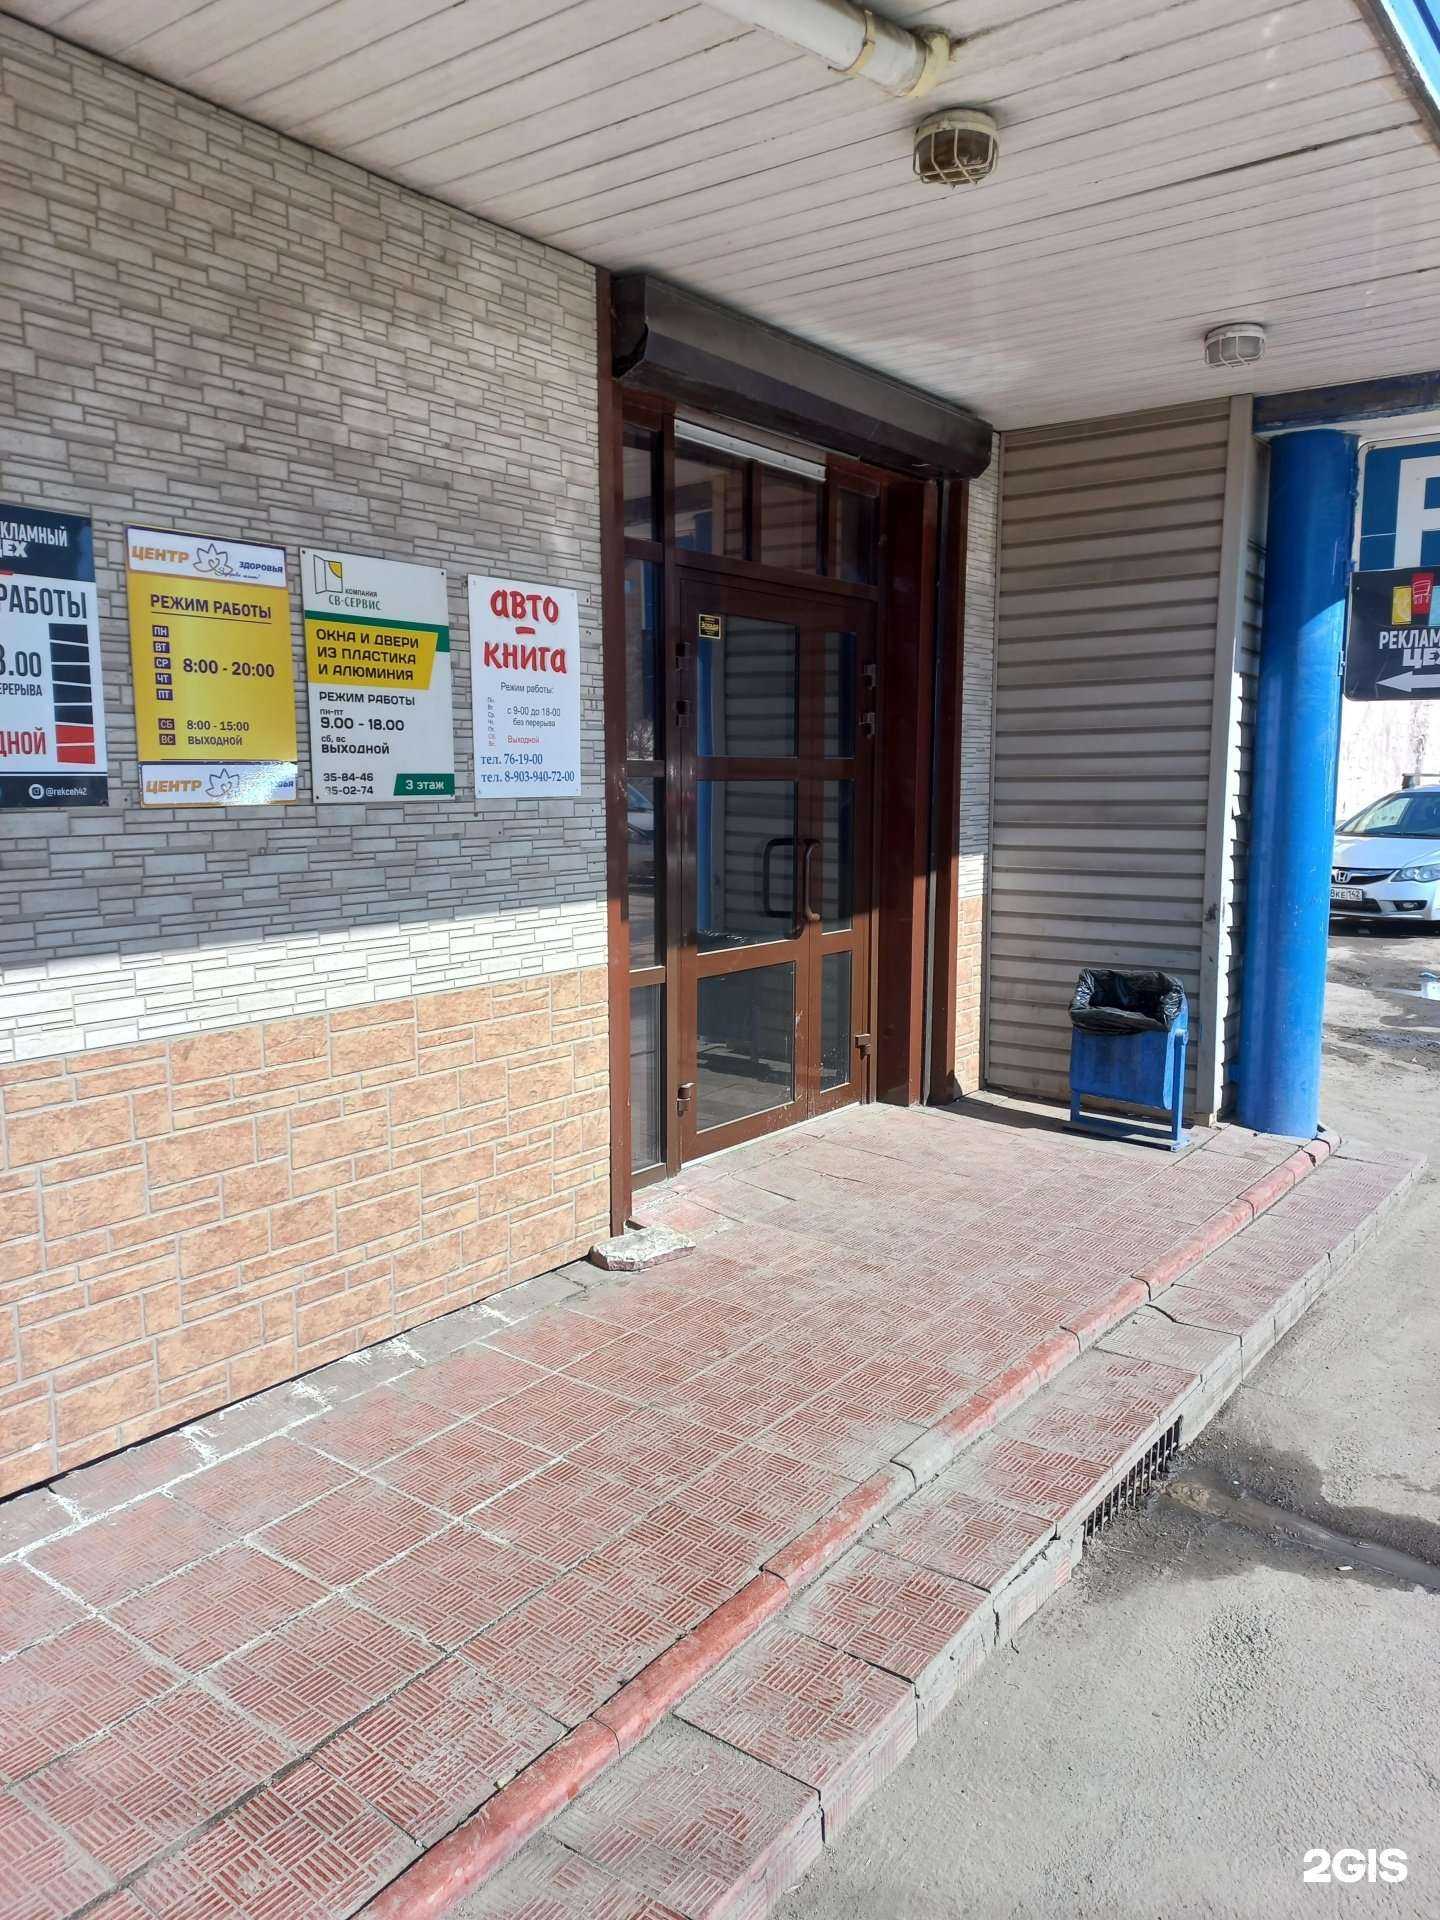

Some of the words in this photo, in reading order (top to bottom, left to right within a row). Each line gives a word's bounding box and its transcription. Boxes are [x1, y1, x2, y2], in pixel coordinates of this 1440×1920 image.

[0, 539, 28, 558] ЕХ
[132, 546, 190, 563] ЦЕНТР
[239, 561, 283, 574] ЗДОРОВЬЯ
[345, 588, 378, 597] КОМПАНИЯ
[150, 594, 209, 613] РЕЖИМ
[214, 601, 272, 619] РАБОТЫ
[154, 626, 168, 636] ПН
[316, 629, 356, 643] ОКНА
[361, 633, 369, 644] И
[374, 635, 419, 649] ДВЕРИ
[155, 642, 167, 652] ВТ
[317, 646, 336, 658] ИЗ
[342, 649, 416, 665] ПЛАСТИКА
[1402, 648, 1440, 669] ЦЕ
[156, 658, 169, 667] СР
[183, 658, 218, 674] 8:00
[232, 661, 275, 677] 20:00
[318, 664, 328, 674] И
[333, 665, 413, 680] АЛЮМИНИЯ
[156, 674, 169, 683] ЧТ
[500, 682, 524, 691] Режим
[158, 690, 170, 699] ПТ
[319, 691, 364, 703] РЕЖИМ
[368, 694, 415, 706] РАБОТЫ
[513, 706, 529, 715] 9-00
[542, 708, 560, 716] 18-00
[160, 719, 173, 729] СБ
[187, 720, 211, 730] 8:00
[220, 721, 249, 731] 15:00
[320, 717, 354, 729] 9.00
[368, 719, 405, 731] 18.00
[512, 718, 524, 726] без
[525, 719, 556, 728] перерыва
[161, 735, 174, 744] ВС
[188, 735, 243, 746] ВЫХОДНОЙ
[507, 735, 540, 744] Выходной
[321, 742, 390, 754] ВЫХОДНОЙ
[480, 755, 501, 764] тел.
[503, 753, 543, 765] 76-19-00
[480, 773, 502, 782] тел.
[146, 779, 202, 794] ЦЕНТР
[405, 780, 413, 790] 3
[417, 780, 445, 790] этаж
